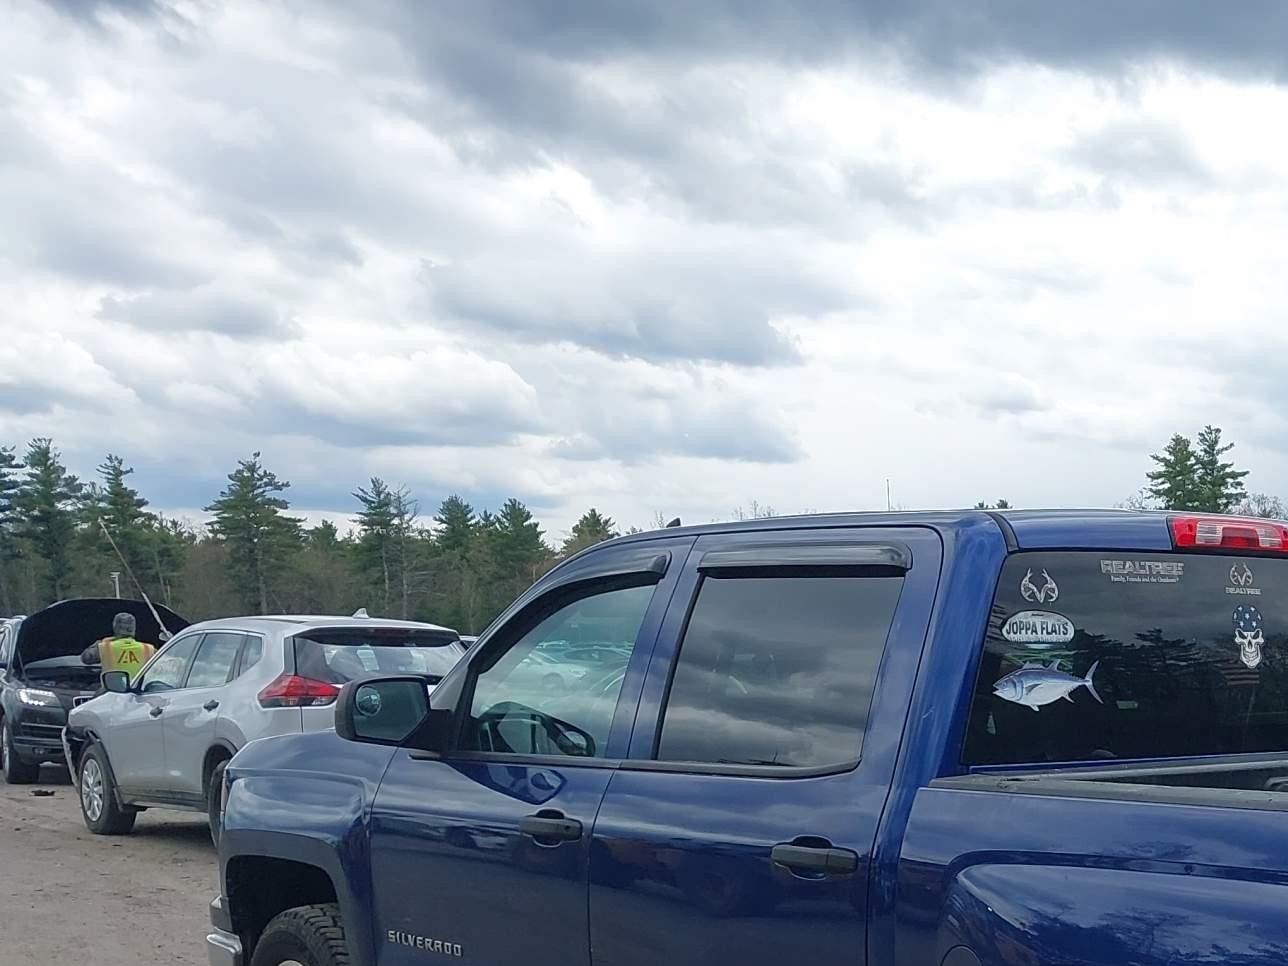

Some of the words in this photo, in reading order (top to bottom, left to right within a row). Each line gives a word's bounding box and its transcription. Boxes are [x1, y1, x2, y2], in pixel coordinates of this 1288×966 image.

[1100, 561, 1184, 575] REALTREE
[1006, 619, 1038, 636] JOPPA
[1040, 620, 1069, 637] FLATS
[388, 930, 462, 957] SILVERADO
